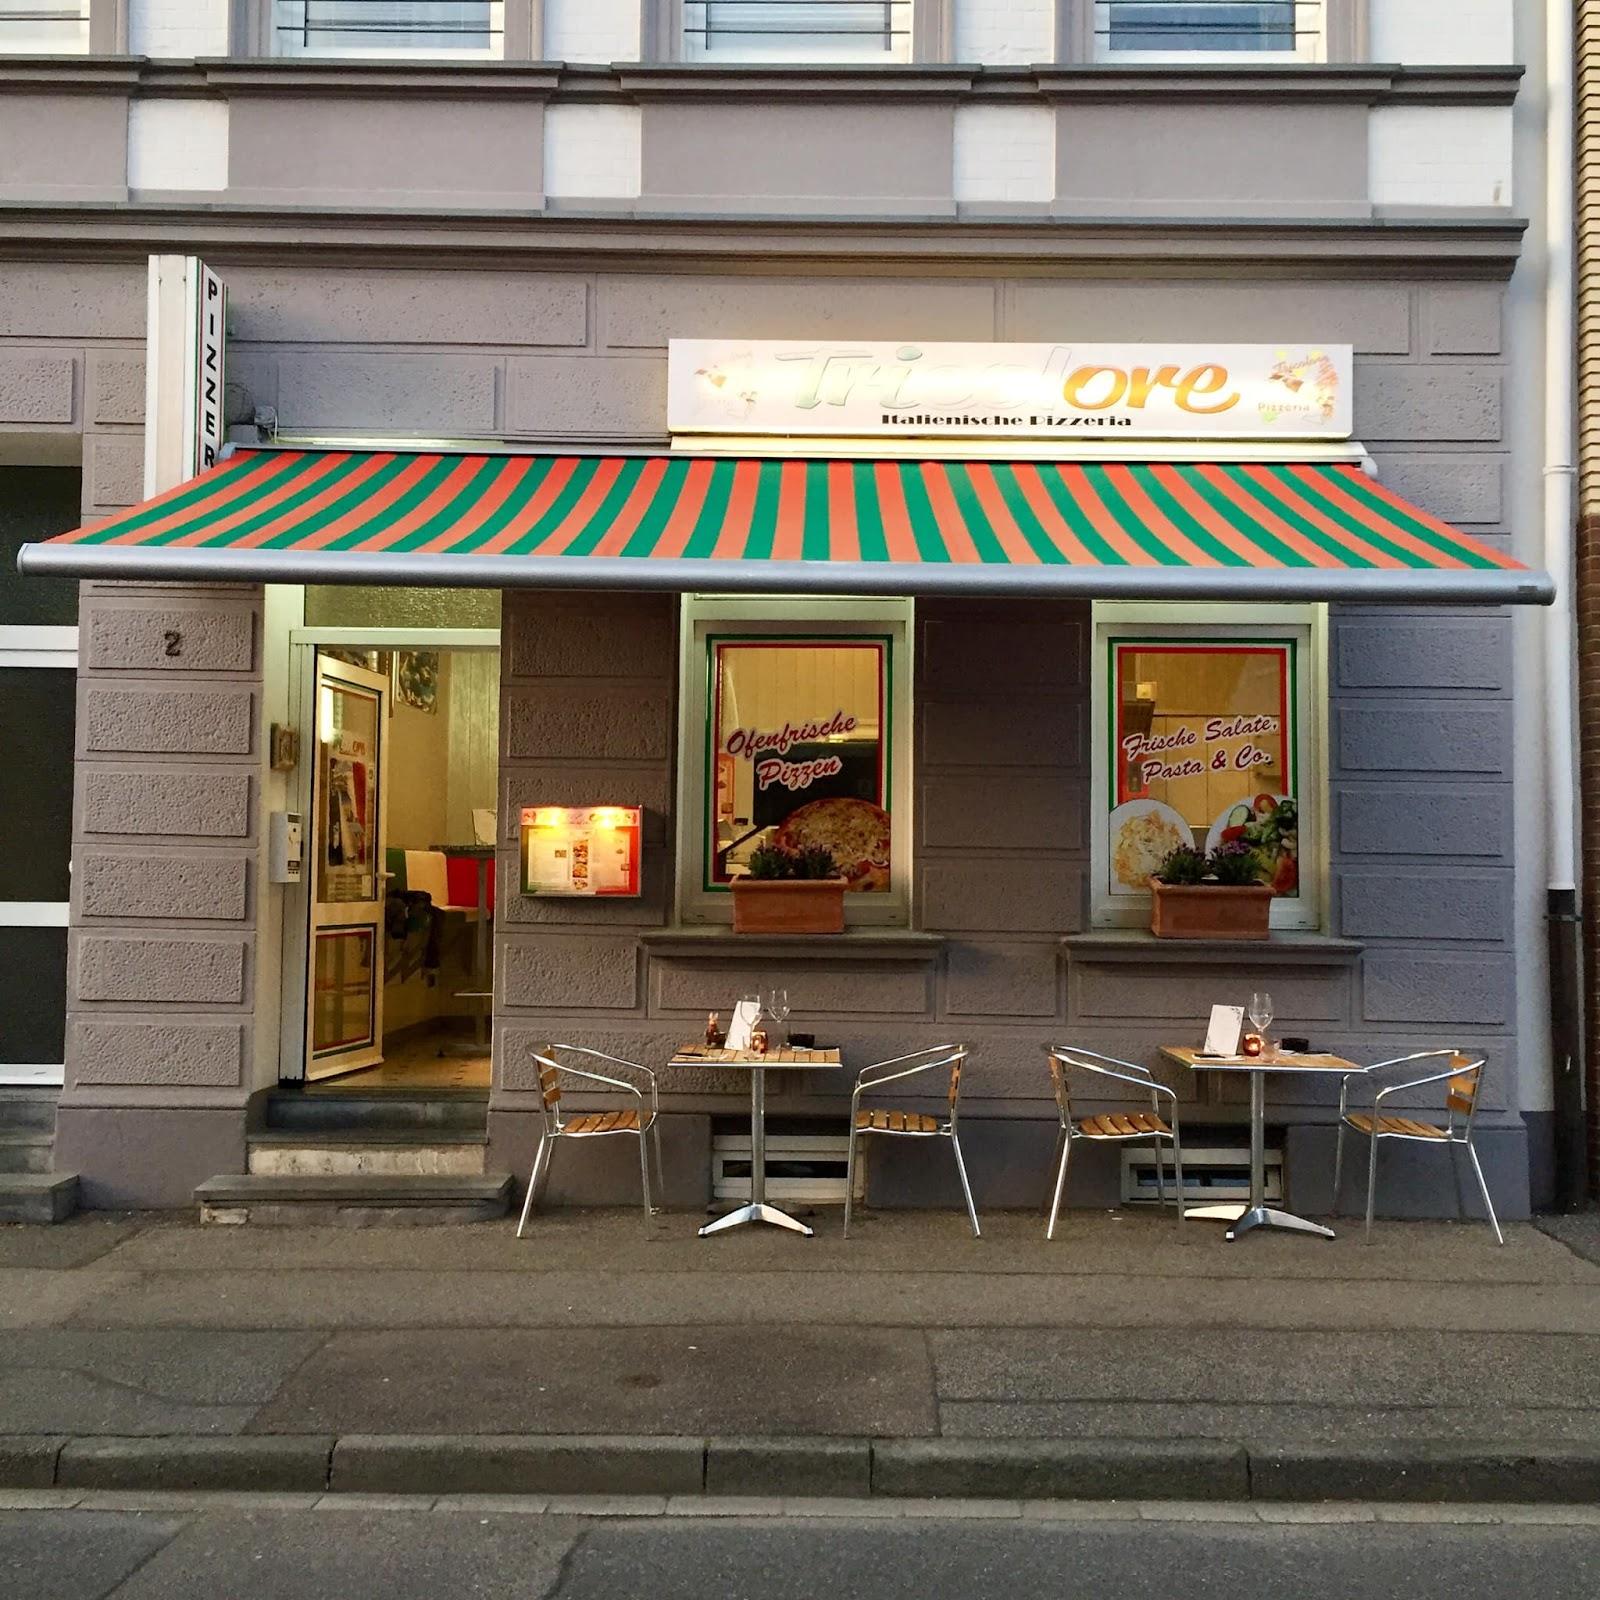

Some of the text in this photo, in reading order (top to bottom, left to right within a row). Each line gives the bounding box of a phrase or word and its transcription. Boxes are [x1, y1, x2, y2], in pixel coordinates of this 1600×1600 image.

[881, 413, 1132, 426] Italienische Pizzeria
[164, 631, 181, 656] 2
[726, 711, 857, 758] Ofenfrische
[1123, 728, 1197, 759] Frische
[757, 756, 842, 790] Pizzen
[1142, 745, 1272, 783] Pasta & Co.
